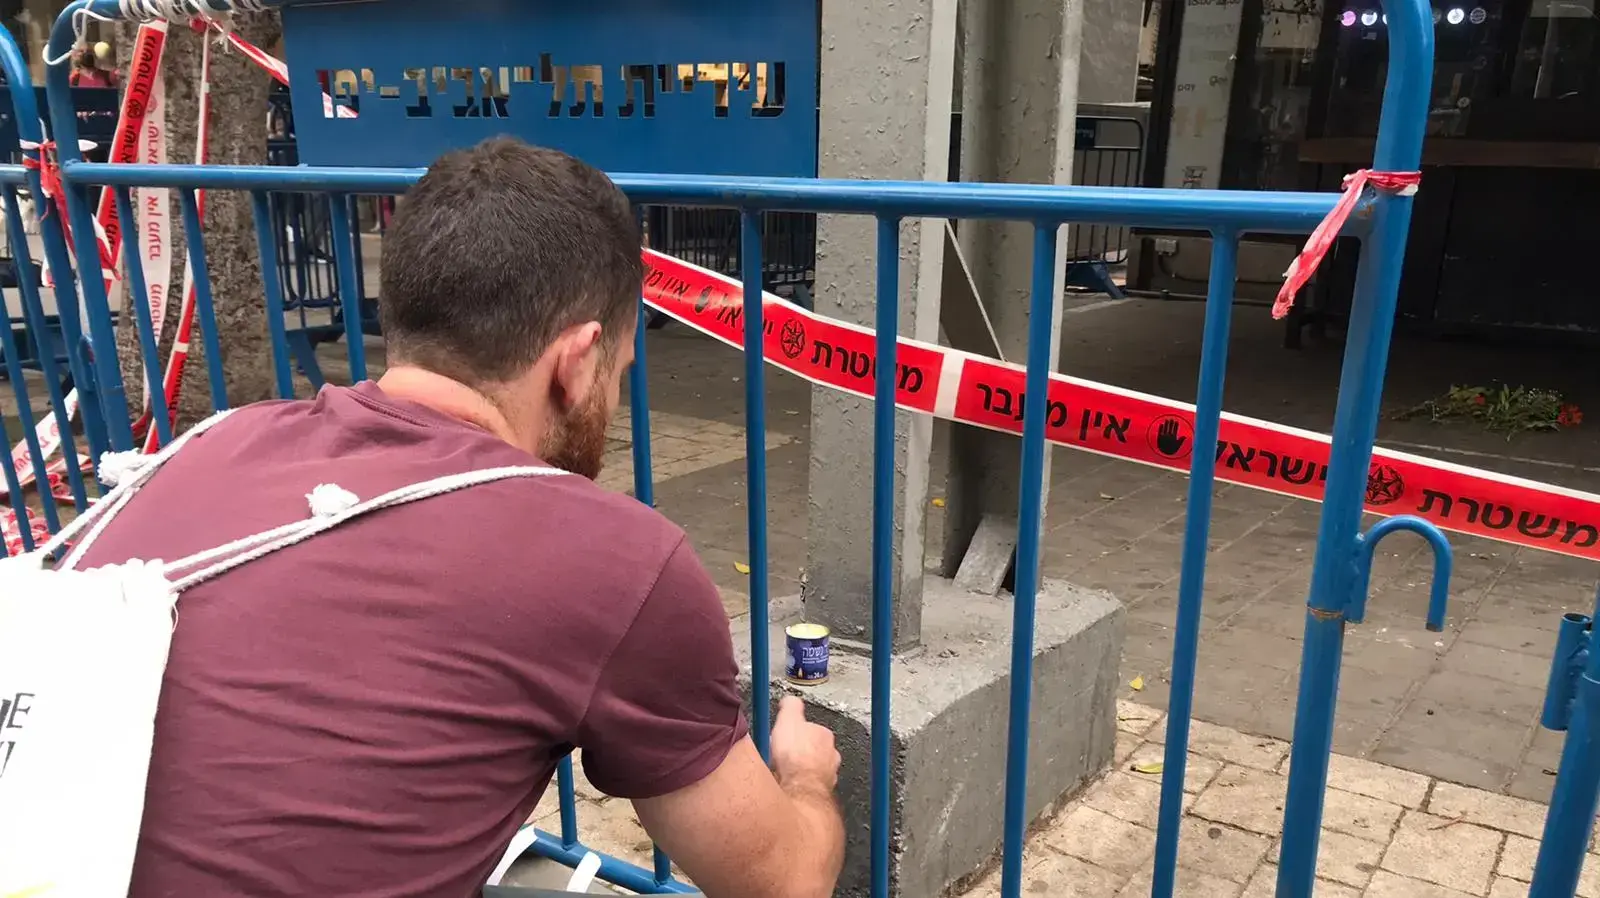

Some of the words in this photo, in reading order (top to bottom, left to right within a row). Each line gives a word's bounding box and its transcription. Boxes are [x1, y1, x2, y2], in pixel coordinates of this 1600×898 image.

[617, 60, 785, 118] עיריית
[120, 124, 136, 163] ישרא
[147, 195, 163, 217] אין
[148, 223, 161, 261] מעבר
[811, 340, 924, 393] מטרת
[1079, 407, 1131, 443] אין
[1416, 488, 1599, 548] משטרת
